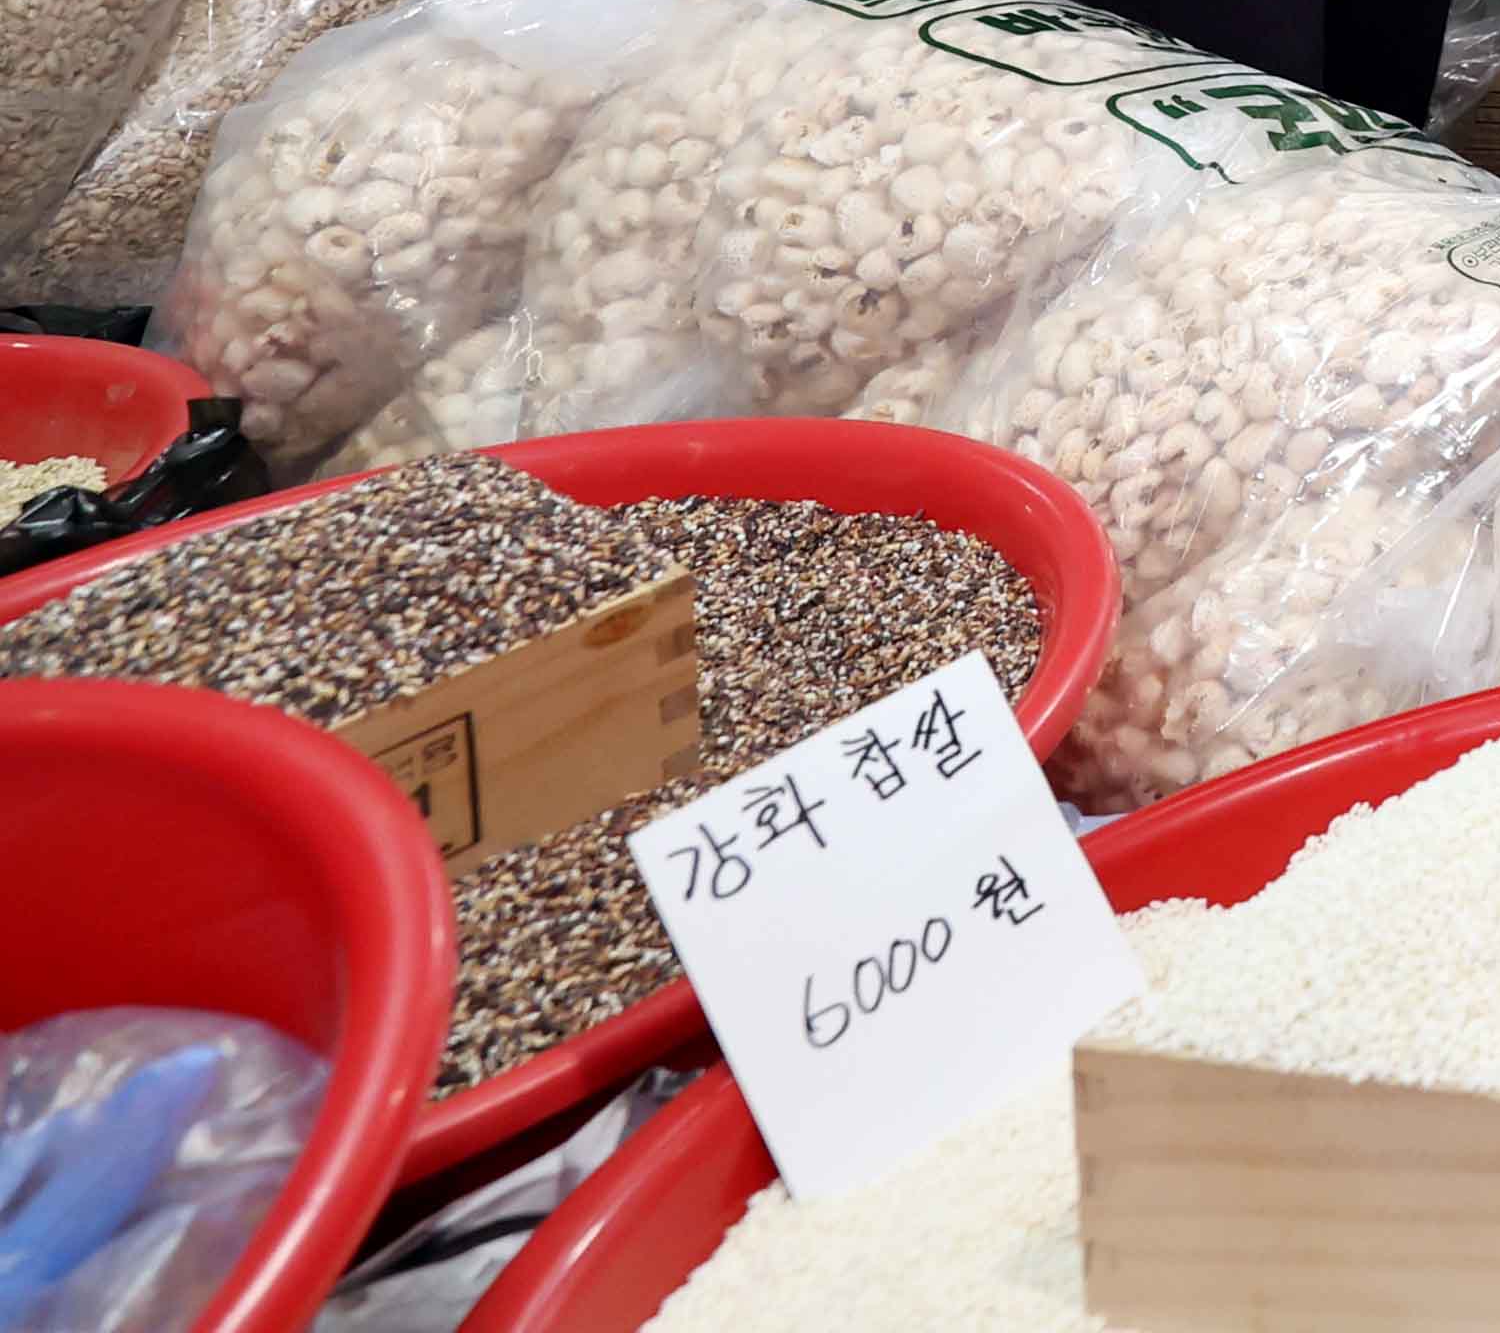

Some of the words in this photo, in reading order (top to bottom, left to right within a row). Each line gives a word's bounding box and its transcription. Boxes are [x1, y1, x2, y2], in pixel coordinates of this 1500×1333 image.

[667, 776, 828, 903] 강화
[840, 688, 987, 802] 찹쌀
[803, 915, 952, 1050] 6000
[970, 854, 1047, 928] 원
